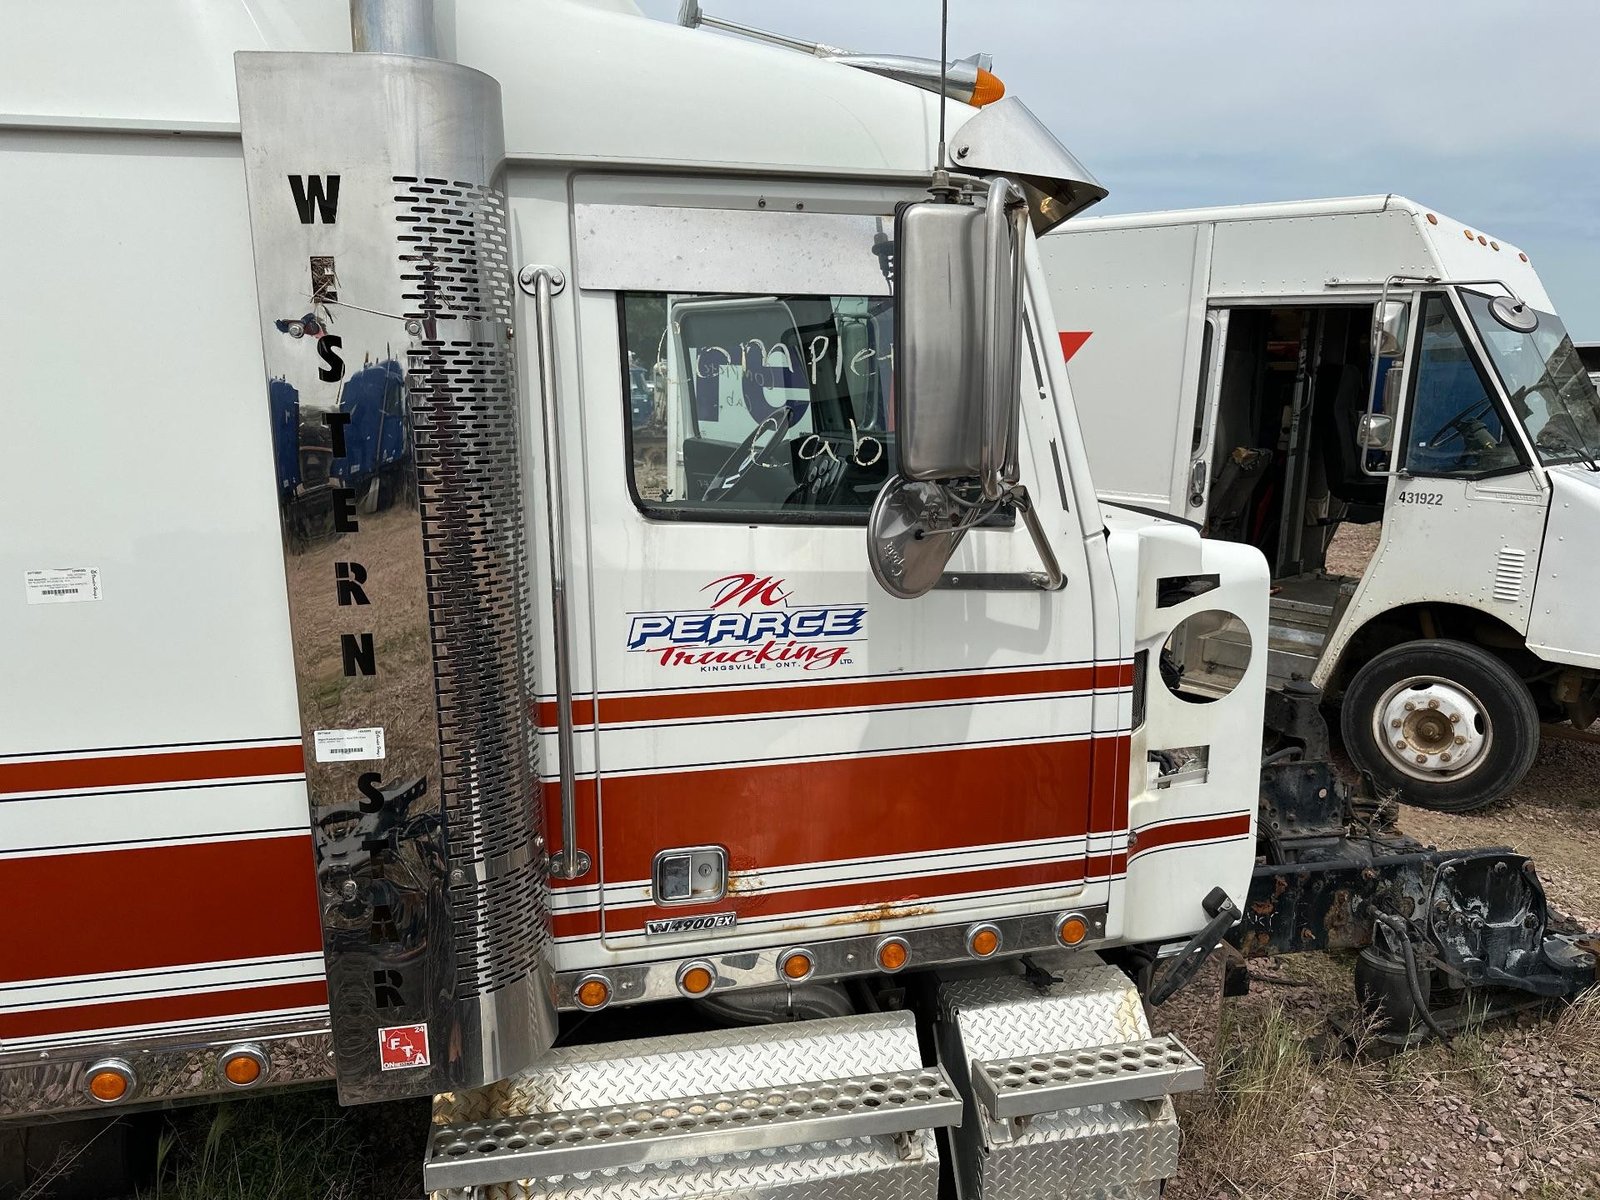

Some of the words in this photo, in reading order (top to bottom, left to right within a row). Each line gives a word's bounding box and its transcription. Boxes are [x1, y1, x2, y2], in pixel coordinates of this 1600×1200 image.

[657, 320, 894, 385] Complet
[750, 417, 883, 468] Cab
[1398, 491, 1444, 506] 431922
[287, 174, 378, 677] WESTERN
[356, 771, 406, 1010] STAR
[627, 608, 869, 649] PEARCE
[646, 640, 851, 671] Trucking
